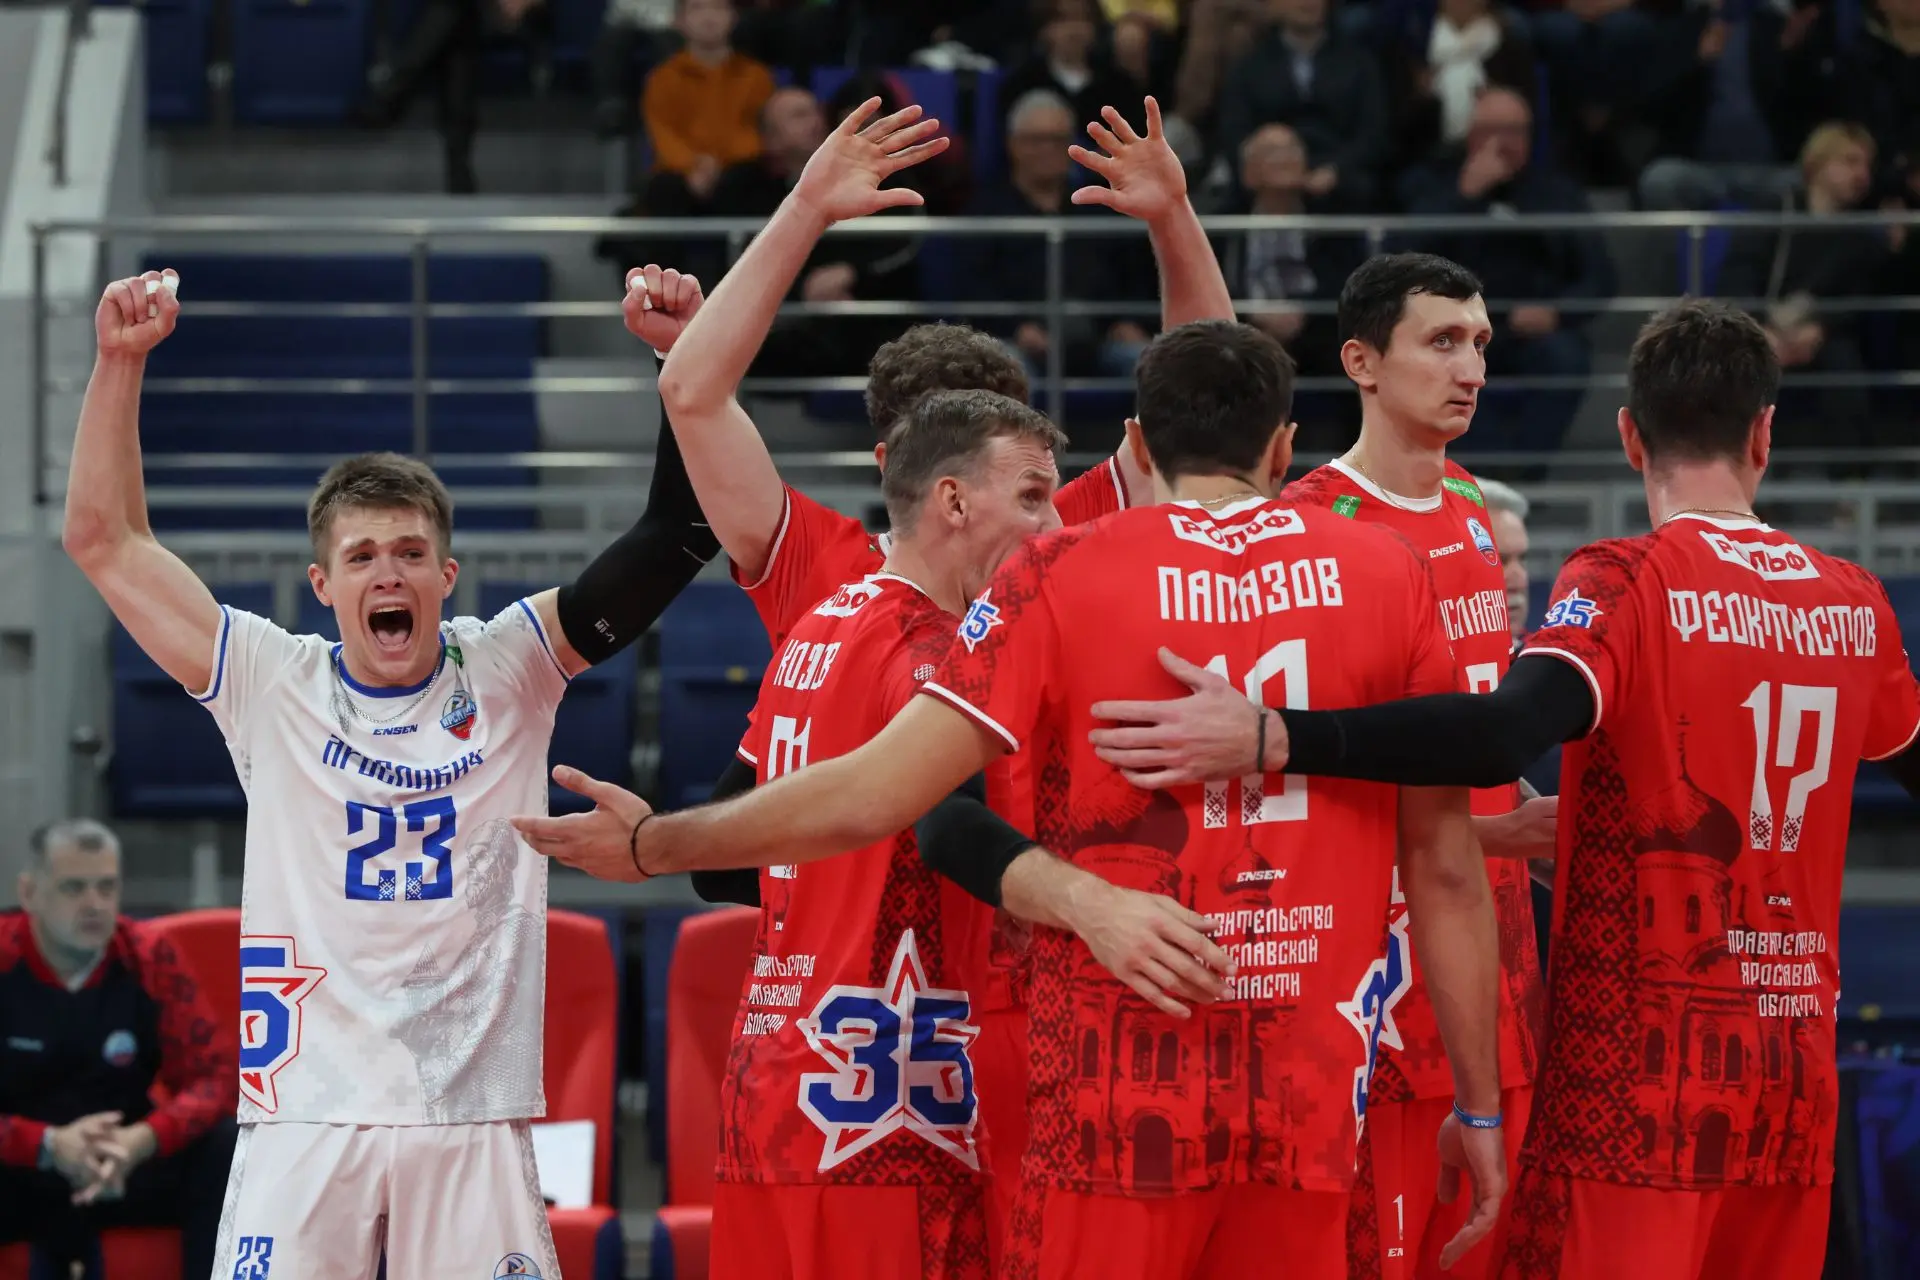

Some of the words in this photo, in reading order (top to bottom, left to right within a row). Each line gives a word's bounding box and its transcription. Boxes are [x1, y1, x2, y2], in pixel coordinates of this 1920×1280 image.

[1429, 542, 1464, 558] ENSEN
[1716, 540, 1806, 572] РЛЬФ
[1157, 557, 1343, 624] ПАПАЗОВ
[1543, 600, 1593, 628] 35
[1668, 589, 1877, 657] ФЕОКТИСТОВ
[373, 724, 418, 736] ENSEN
[1740, 680, 1838, 852] 17
[345, 795, 456, 901] 23
[1236, 869, 1287, 883] ENSEN
[1203, 904, 1334, 938] ВИТЕЛЬСТВО
[1219, 934, 1319, 968] СЛАВСКОЙ
[1221, 972, 1301, 1001] БЛАСТИ
[807, 995, 974, 1126] 35
[232, 1236, 274, 1280] 23
